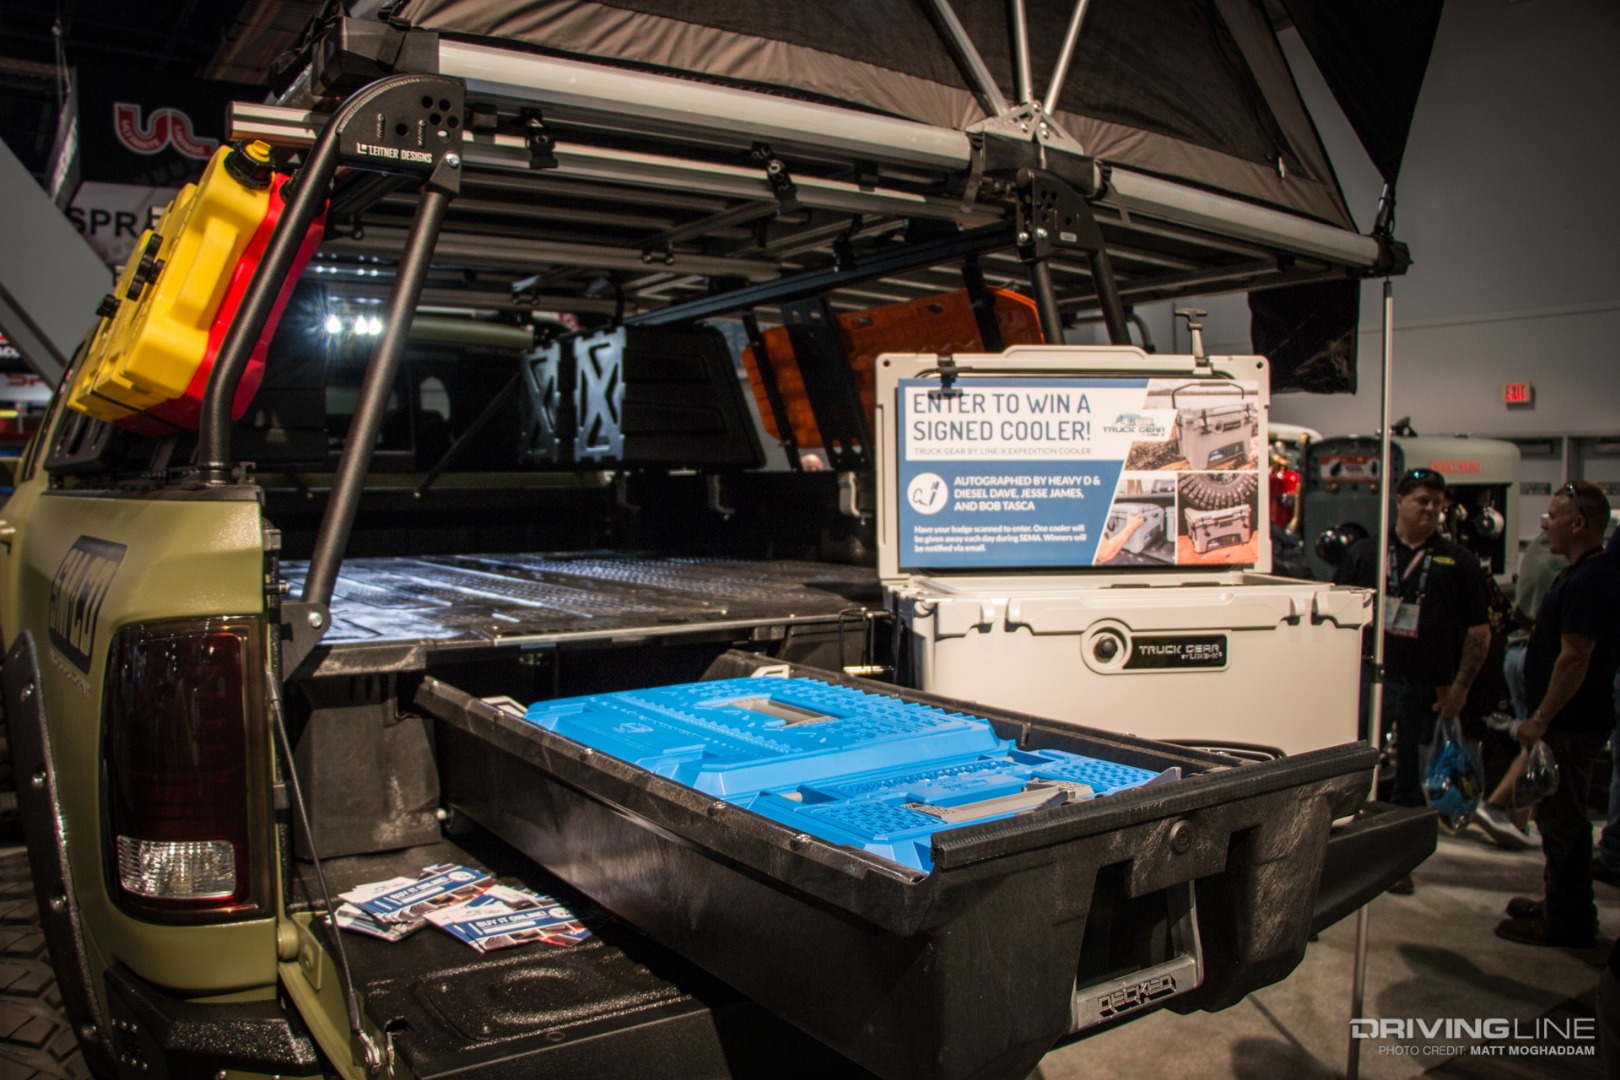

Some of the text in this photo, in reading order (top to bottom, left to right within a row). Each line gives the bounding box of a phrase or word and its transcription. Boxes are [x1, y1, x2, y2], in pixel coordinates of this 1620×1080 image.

[368, 146, 432, 163] LEITNER DESIGNS
[913, 393, 1091, 414] ENTER TO WIN A
[913, 421, 1091, 441] SIGNED COOLER!
[954, 476, 1100, 486] AUTOGRAPHED BY HEAVY D &
[954, 488, 1084, 500] DIESEL DAVE, JESSE JAMES,
[954, 501, 1035, 511] AND BOB TASCA
[952, 526, 973, 534] badge
[974, 525, 1002, 533] scanned
[1072, 524, 1084, 532] will
[924, 535, 944, 544] given
[982, 535, 994, 543] day
[996, 535, 1019, 543] during
[914, 544, 923, 552] be
[925, 544, 952, 552] notified
[954, 544, 963, 552] via
[1138, 644, 1220, 655] TRUCK GEAR
[476, 918, 497, 927] BUY
[1098, 974, 1175, 1014] DECKED
